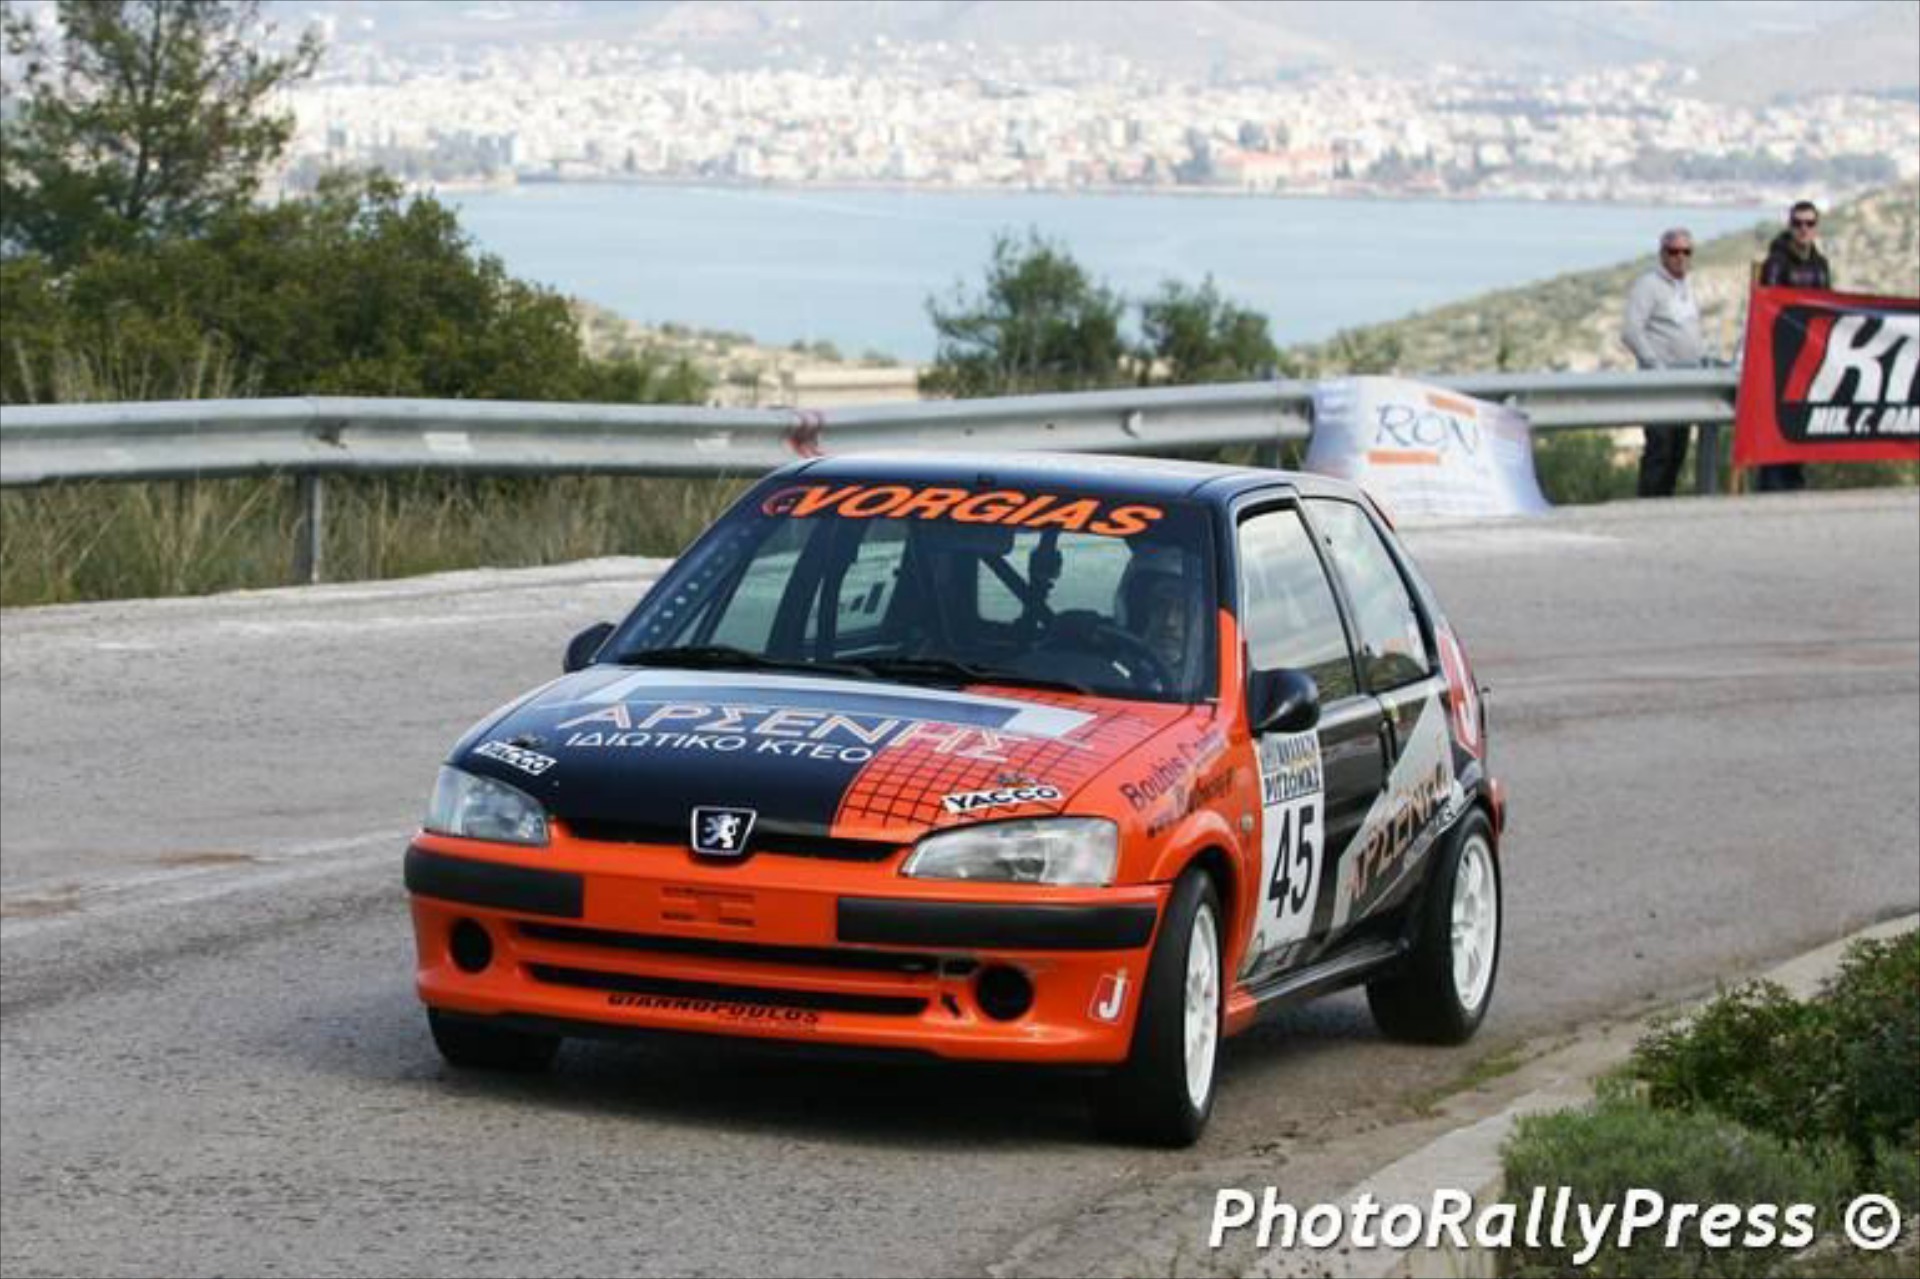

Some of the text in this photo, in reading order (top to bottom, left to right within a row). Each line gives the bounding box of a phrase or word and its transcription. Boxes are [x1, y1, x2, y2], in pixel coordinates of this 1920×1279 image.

[790, 485, 1164, 538] VORGIAS
[557, 702, 1030, 763] ΑΡΣΕΝΗΣ
[565, 731, 873, 762] ΙΔΙΩΤΙΚΟ ΚΤΕΟ
[946, 786, 1060, 811] YACCO
[1267, 804, 1315, 919] 45
[1098, 968, 1128, 1019] J
